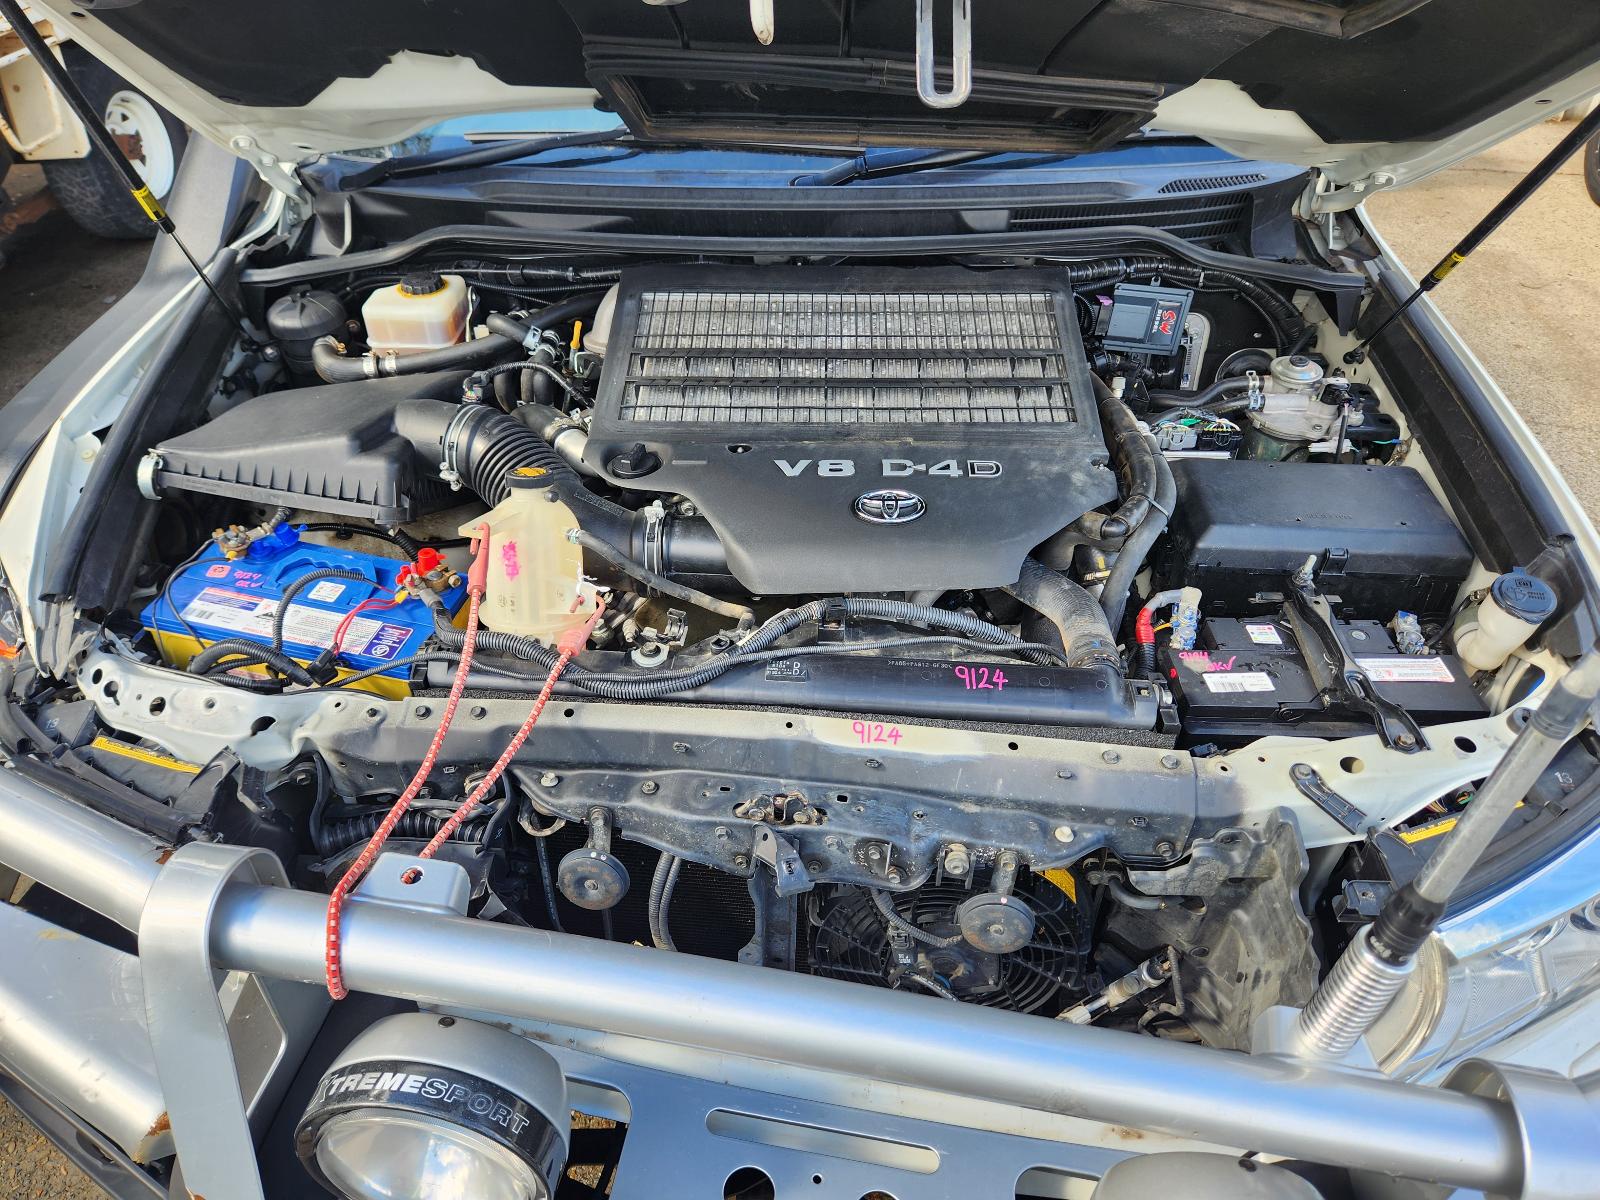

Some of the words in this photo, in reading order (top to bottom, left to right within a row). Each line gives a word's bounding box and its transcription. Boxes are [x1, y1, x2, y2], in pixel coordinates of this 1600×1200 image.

[773, 459, 856, 477] V8
[881, 459, 1003, 478] D-4D
[954, 665, 1009, 691] 9124
[852, 719, 903, 745] 9124
